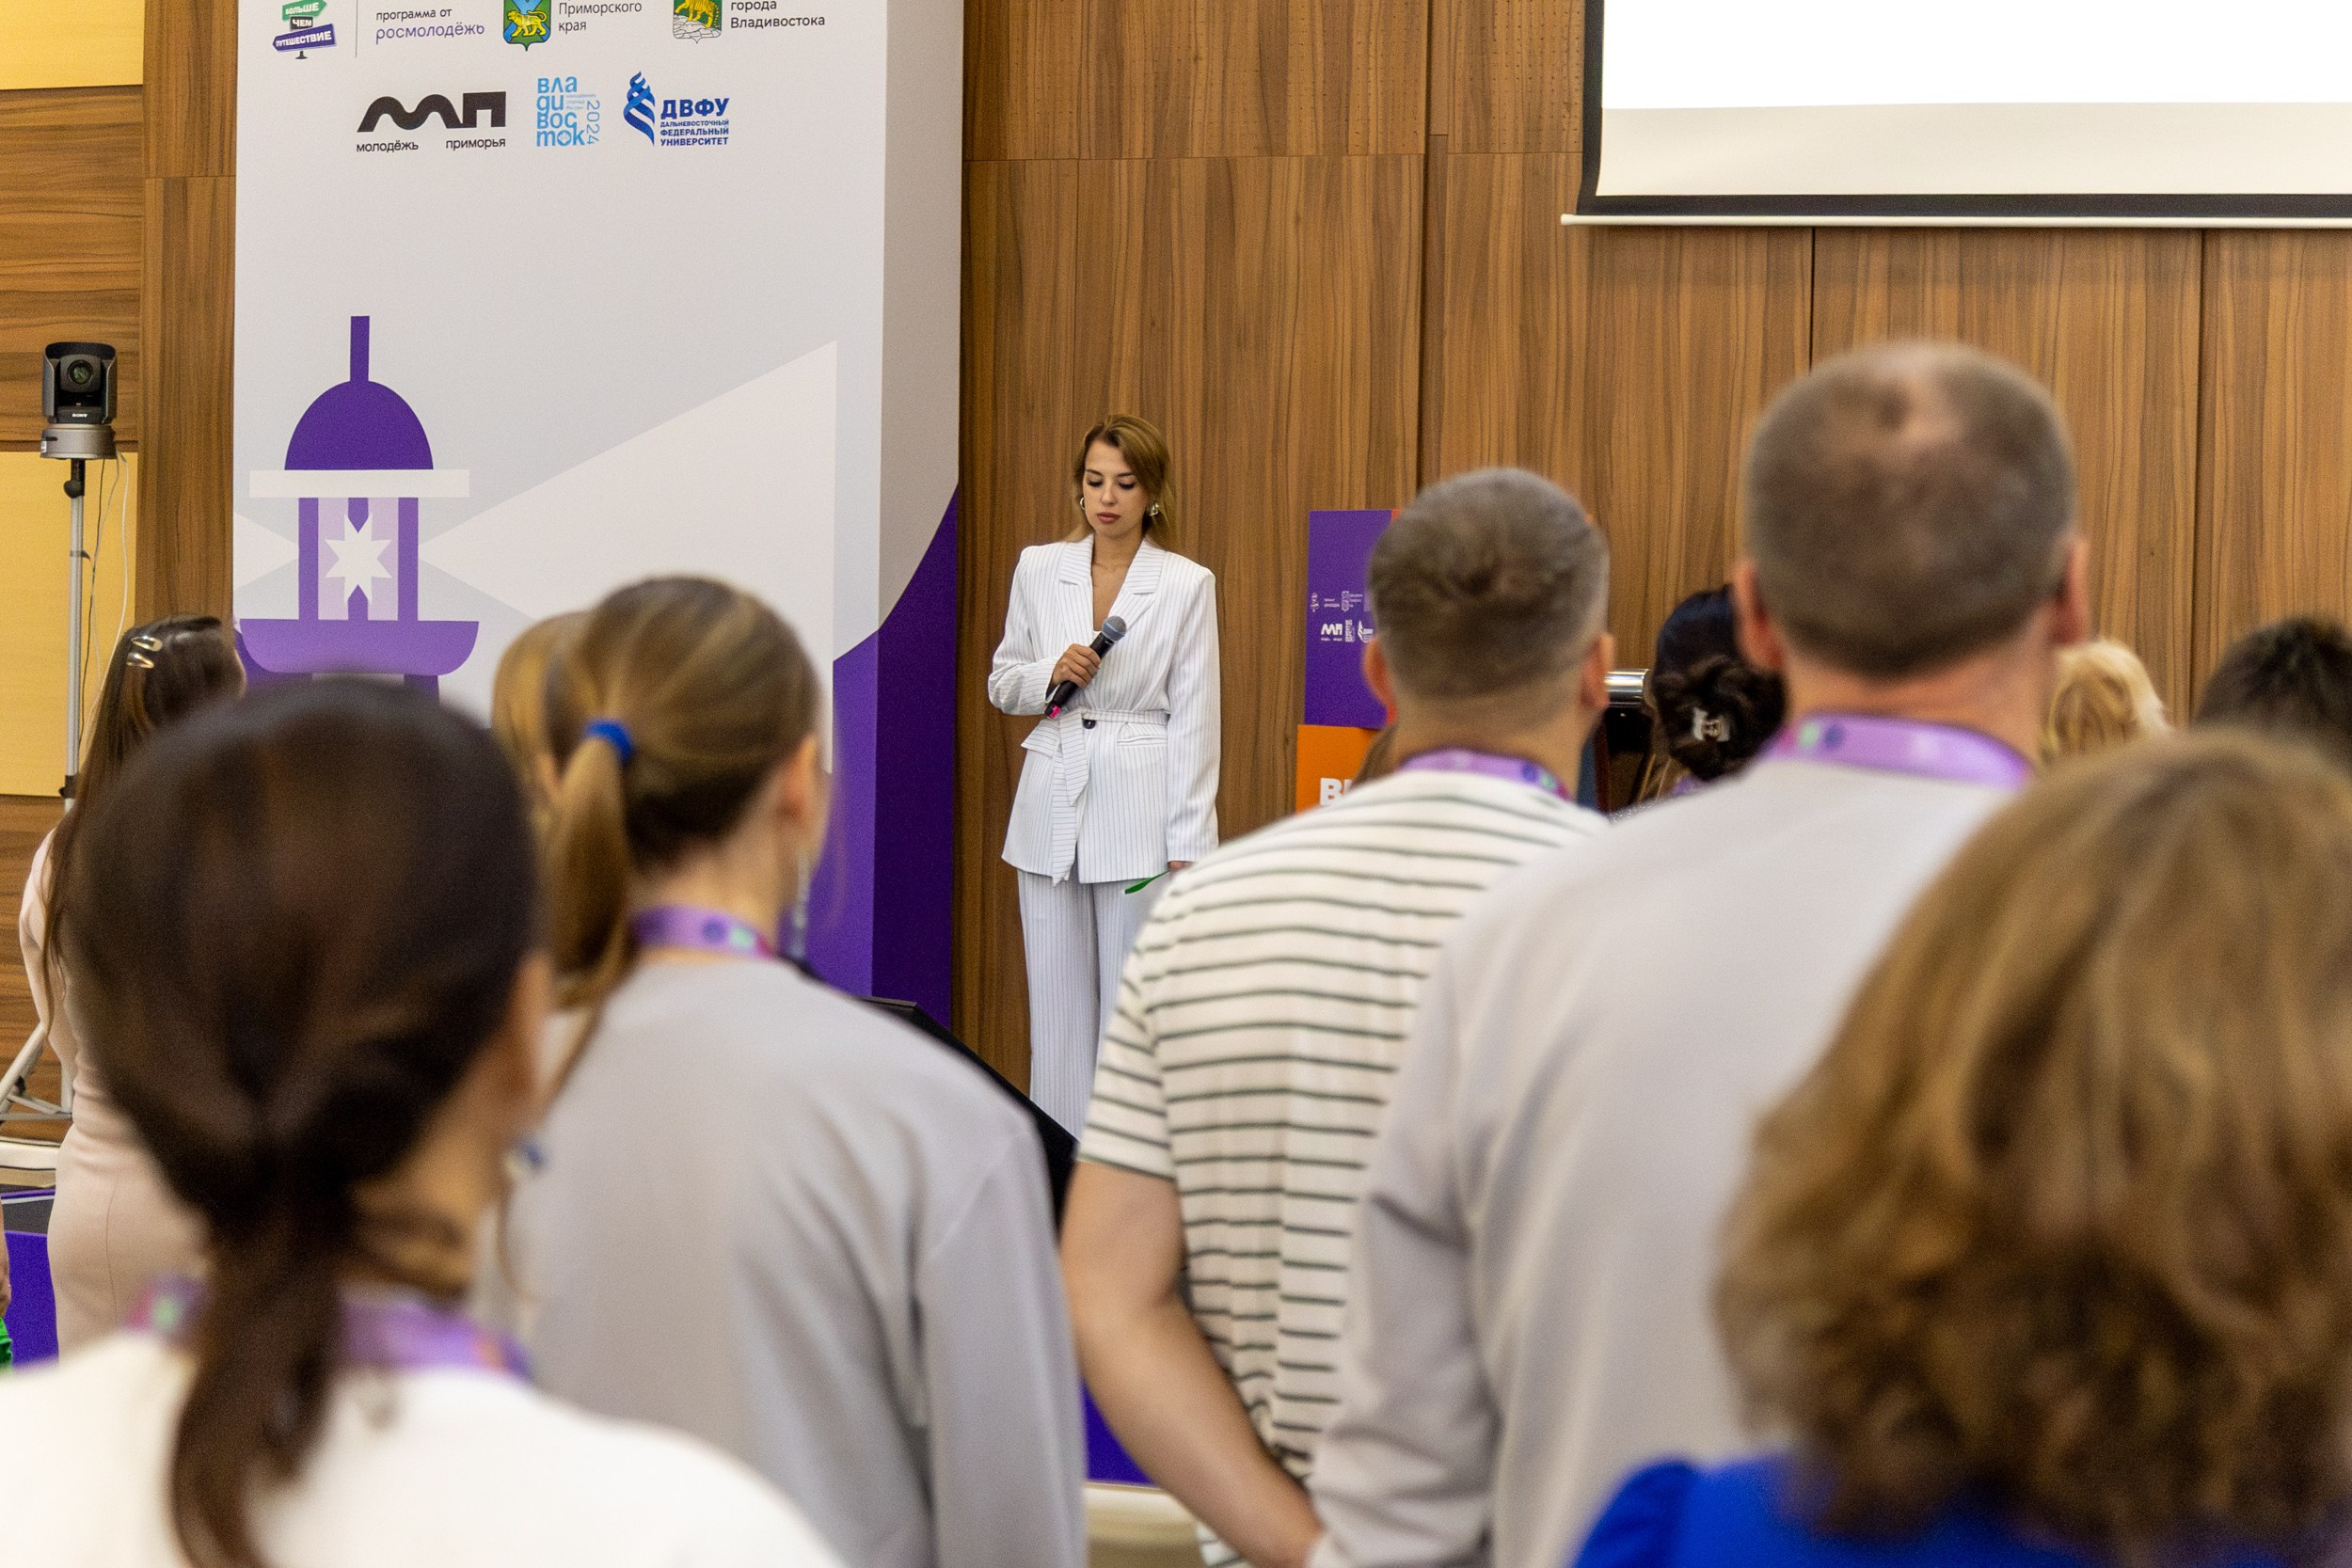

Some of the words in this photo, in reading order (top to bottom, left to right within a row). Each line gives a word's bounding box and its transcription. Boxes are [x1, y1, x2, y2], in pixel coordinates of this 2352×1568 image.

[558, 2, 643, 17] Приморского
[730, 0, 777, 12] города
[375, 8, 437, 23] программа
[439, 8, 453, 18] от
[292, 19, 312, 27] ЧЕМ
[558, 21, 587, 34] края
[730, 16, 826, 29] Владивостока
[275, 30, 332, 48] ПУТЕШЕСТВИЕ
[375, 22, 485, 45] росмолодёжь
[660, 98, 730, 119] ДВФУ
[586, 100, 601, 145] 2024
[660, 119, 729, 127] ДАЛЬНЕВОСТОЧНЫЙ
[660, 126, 729, 136] ФЕДЕРАЛЬНЫЙ
[356, 140, 420, 152] молодёжь
[445, 138, 506, 150] приморья
[660, 136, 729, 147] УНИВЕРСИТЕТ
